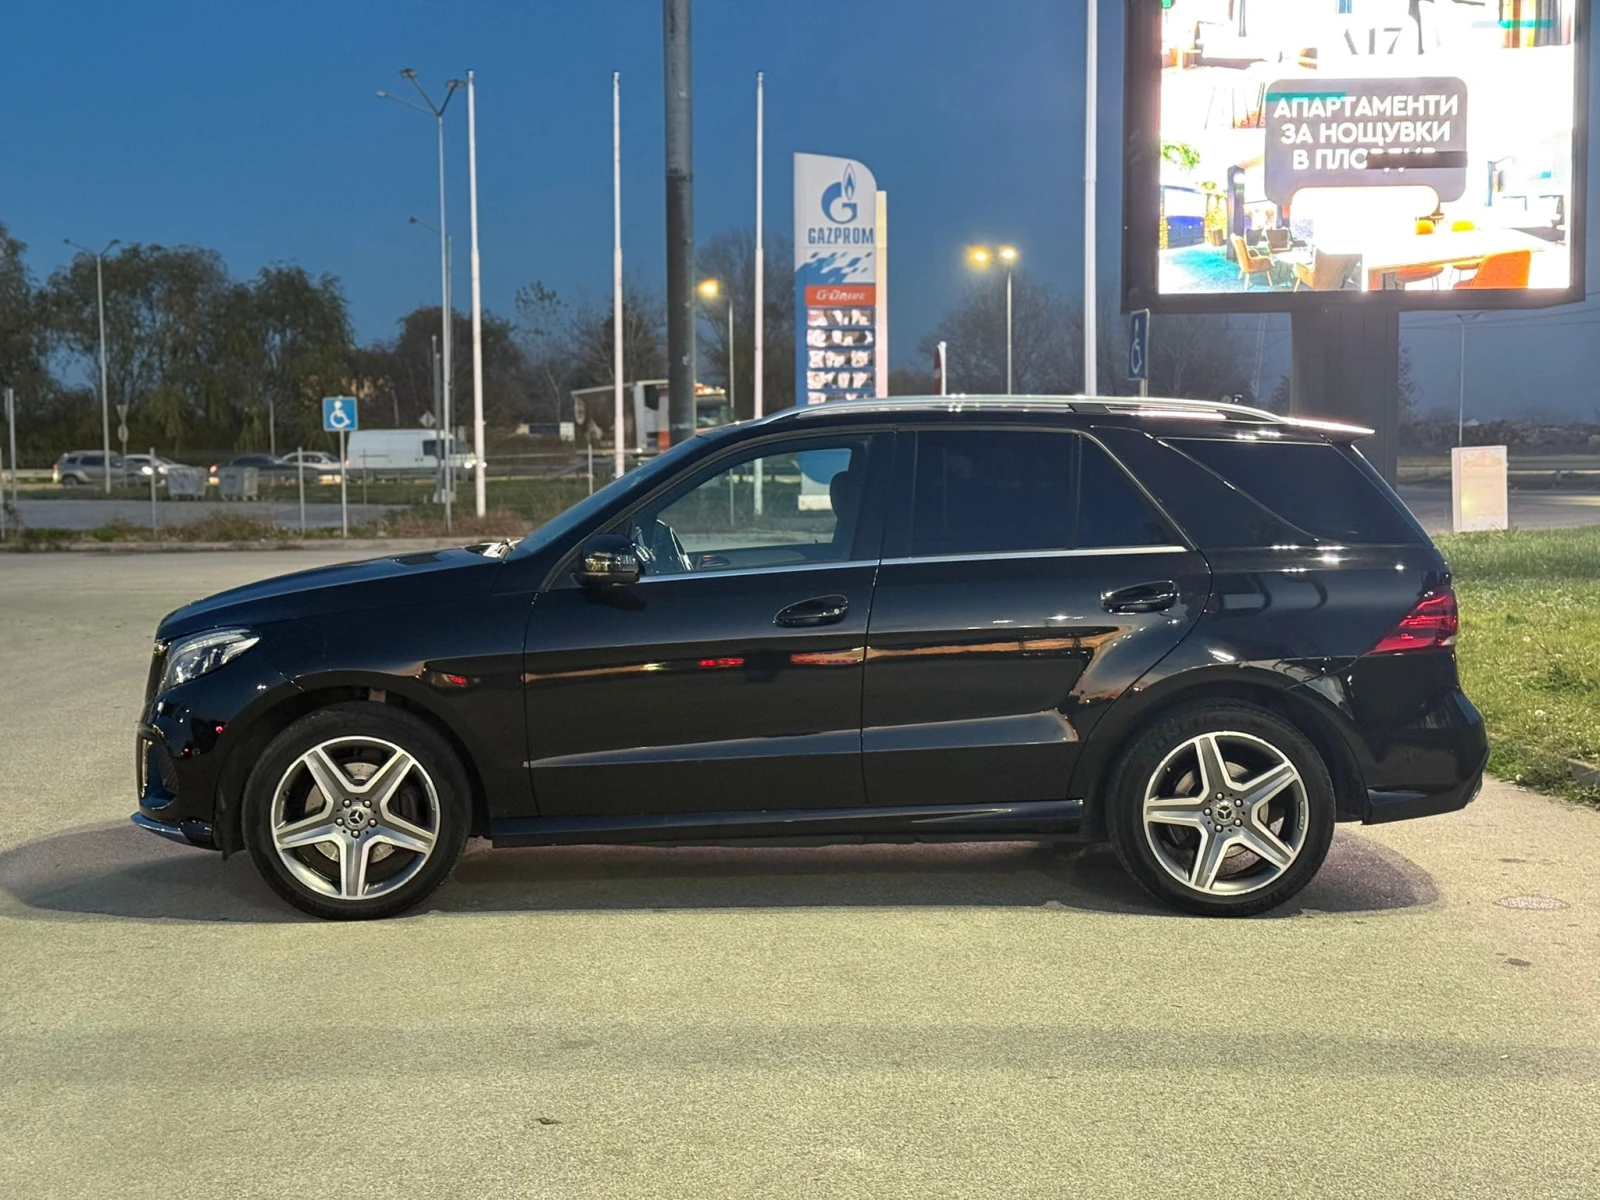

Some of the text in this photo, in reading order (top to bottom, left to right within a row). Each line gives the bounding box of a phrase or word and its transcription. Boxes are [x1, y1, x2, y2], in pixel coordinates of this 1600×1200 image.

[1273, 94, 1459, 118] АПАРТАМЕНТИ
[1280, 120, 1451, 146] ЗА НОЩУВКИ
[1292, 148, 1309, 170] В
[808, 227, 874, 244] GAZPROM
